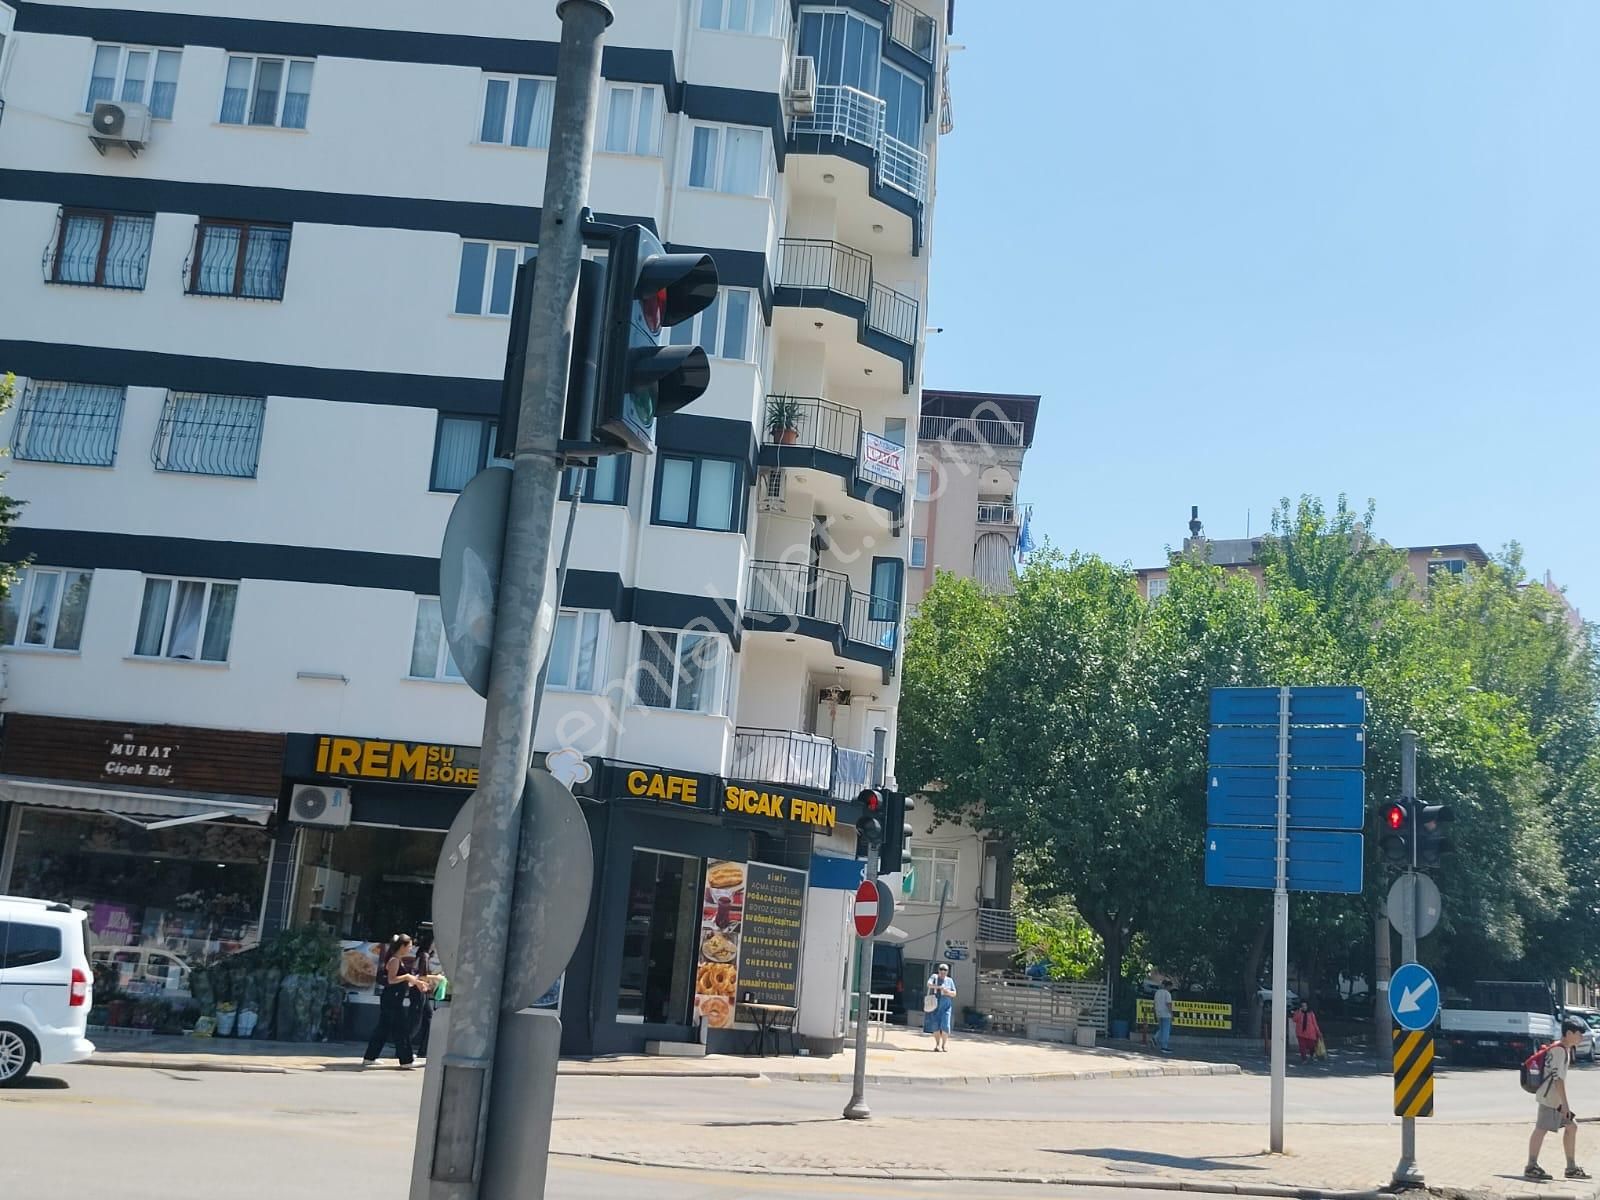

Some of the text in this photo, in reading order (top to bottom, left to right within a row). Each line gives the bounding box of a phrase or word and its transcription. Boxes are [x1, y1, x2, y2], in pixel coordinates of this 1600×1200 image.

[111, 743, 172, 758] MURAT
[428, 746, 455, 763] SU
[105, 761, 172, 776] Çiçek Evi
[426, 762, 480, 784] BÖRE
[627, 770, 698, 803] CAFE
[725, 786, 836, 828] SICAK FIRIN
